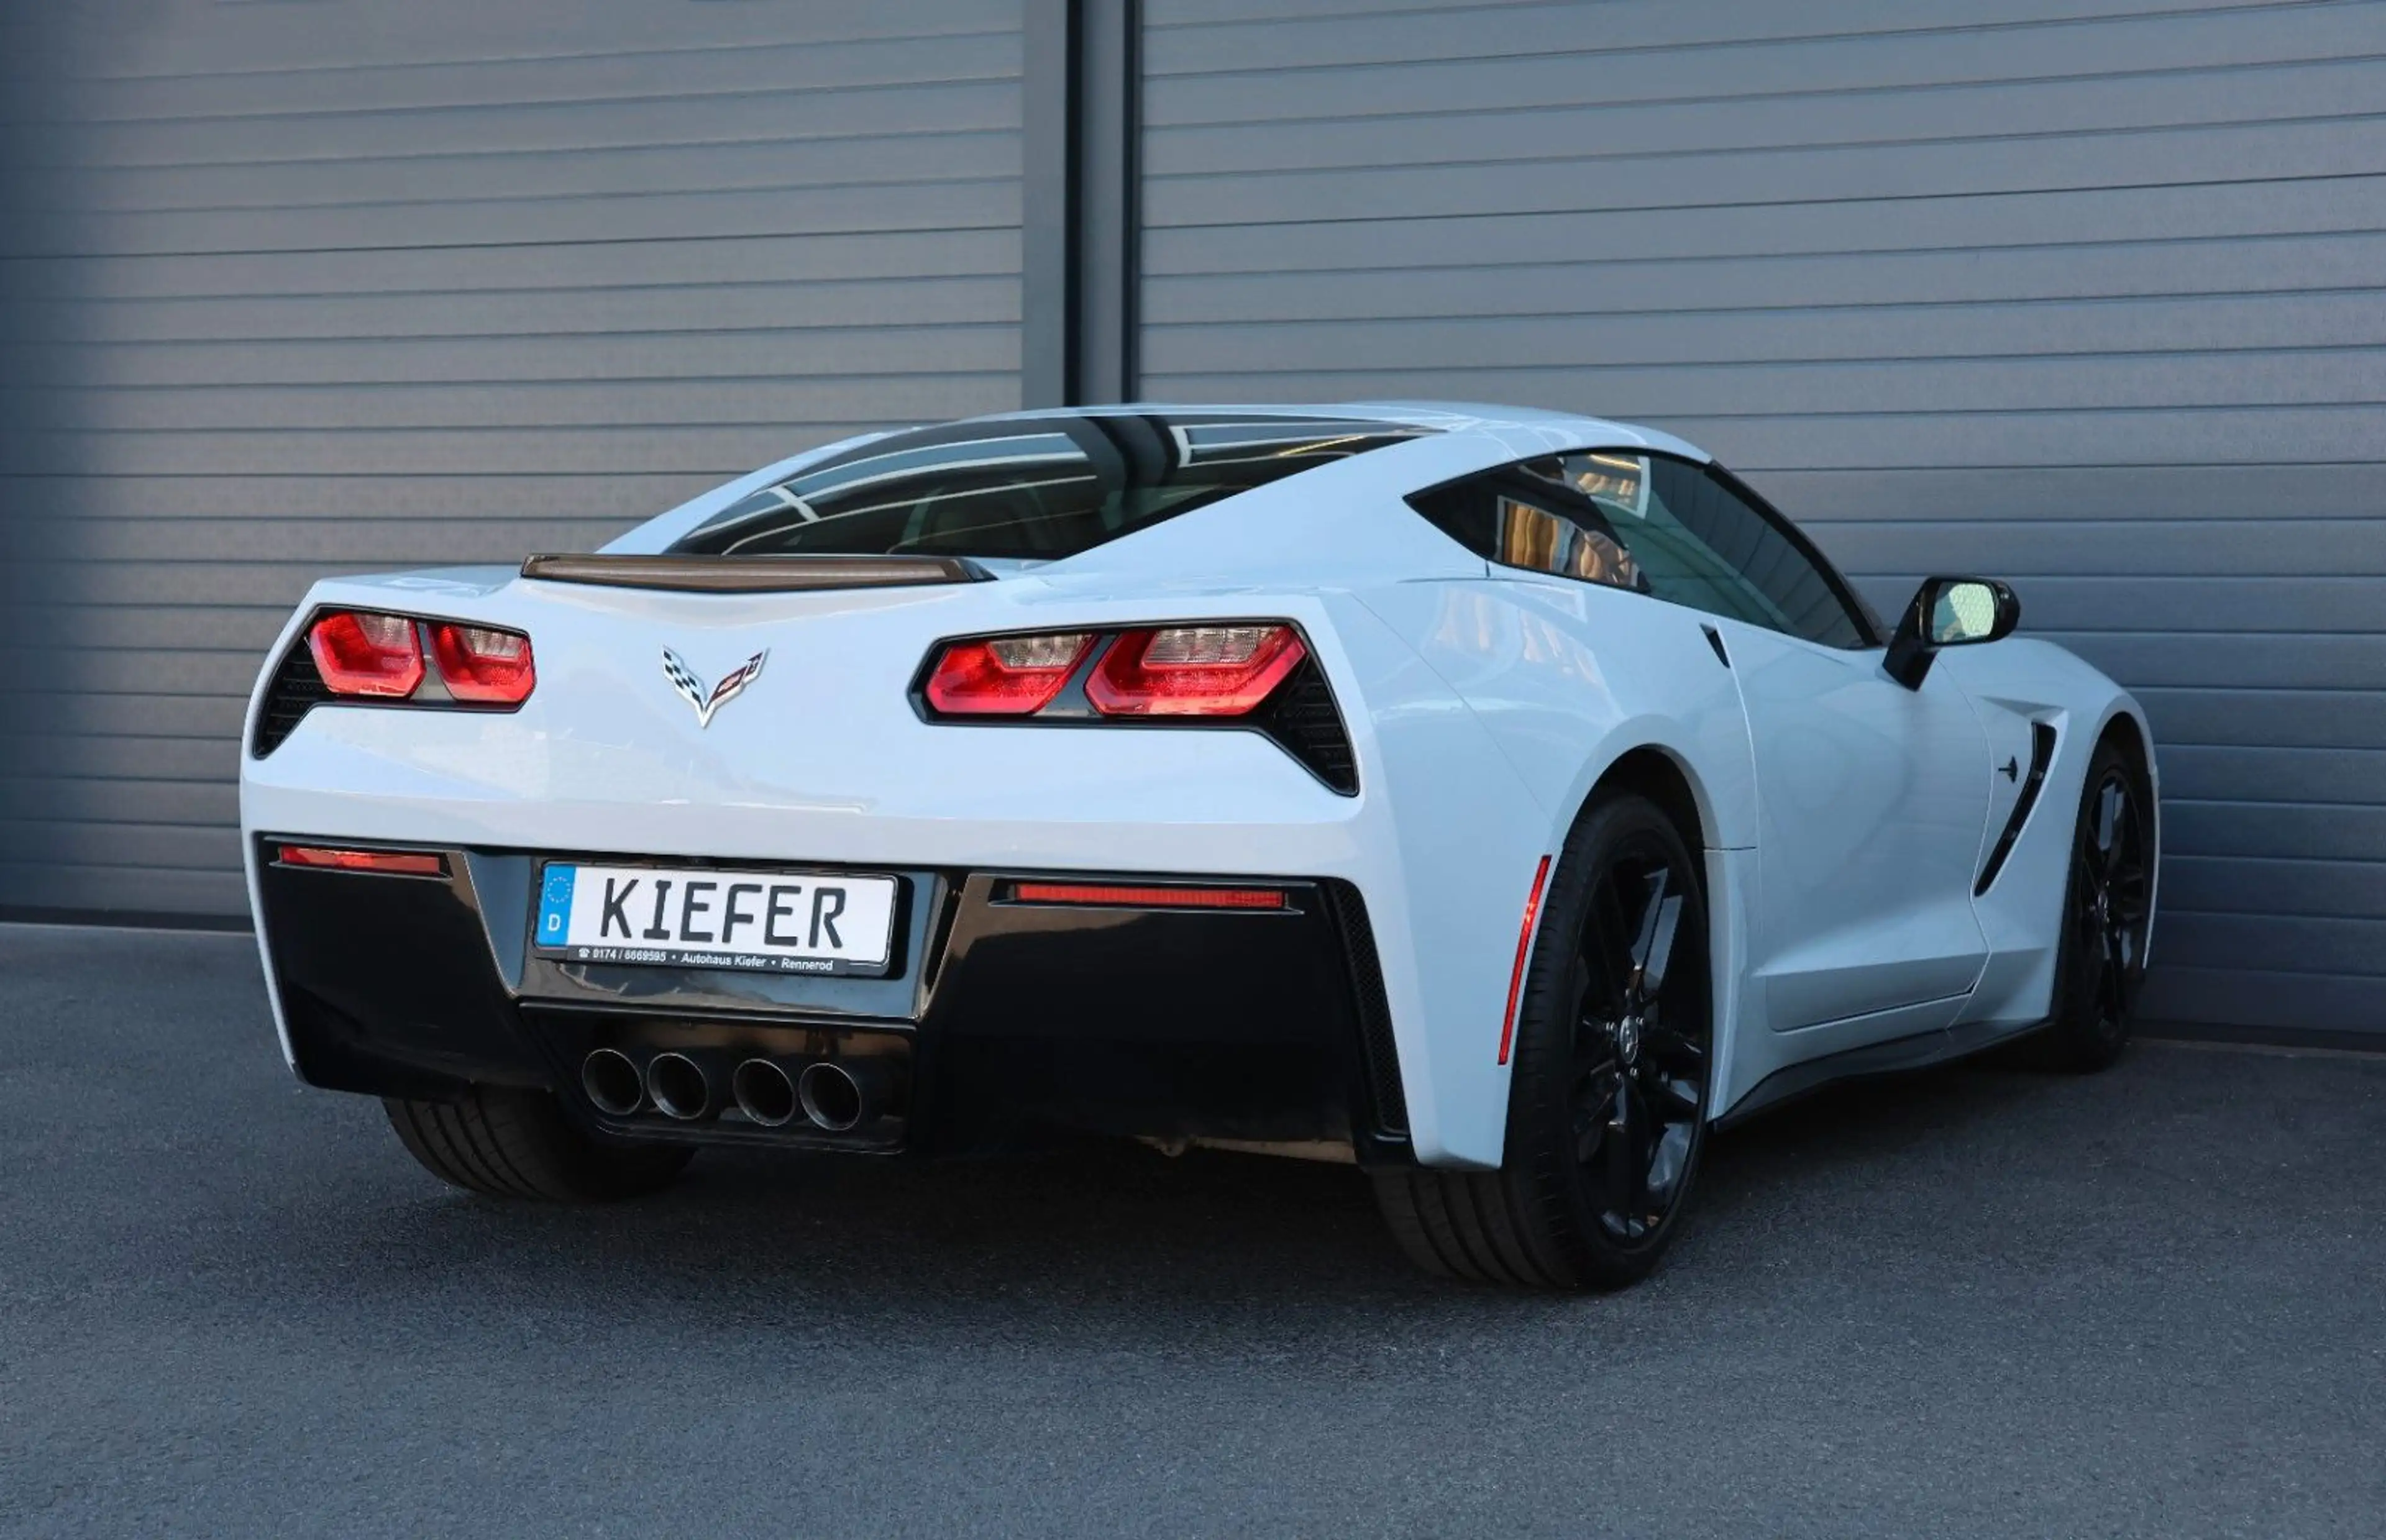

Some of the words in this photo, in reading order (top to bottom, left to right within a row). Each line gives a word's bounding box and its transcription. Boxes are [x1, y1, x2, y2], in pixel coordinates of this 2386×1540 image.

[547, 913, 560, 931] D
[600, 878, 846, 949] KIEFER
[593, 949, 617, 960] 0174
[680, 952, 731, 966] Autohaus
[734, 955, 767, 967] Kiefer
[781, 957, 833, 971] Rennerod
